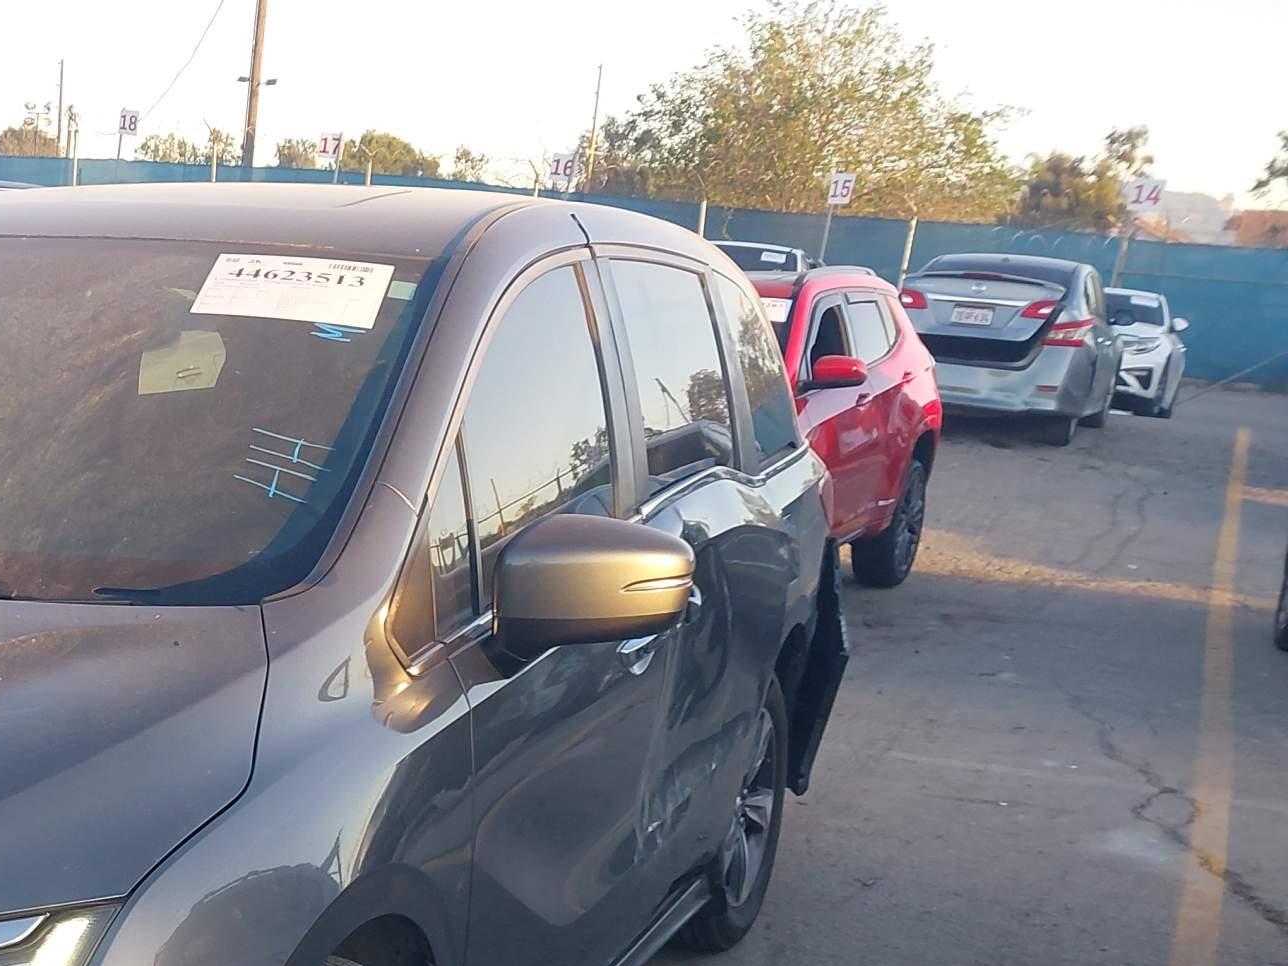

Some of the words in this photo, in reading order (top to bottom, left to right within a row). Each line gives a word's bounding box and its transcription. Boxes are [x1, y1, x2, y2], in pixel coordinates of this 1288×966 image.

[119, 113, 137, 131] 18
[319, 137, 340, 155] 17
[550, 158, 574, 177] 16
[830, 179, 853, 198] 15
[1130, 184, 1162, 206] 14
[228, 267, 365, 287] 44623513
